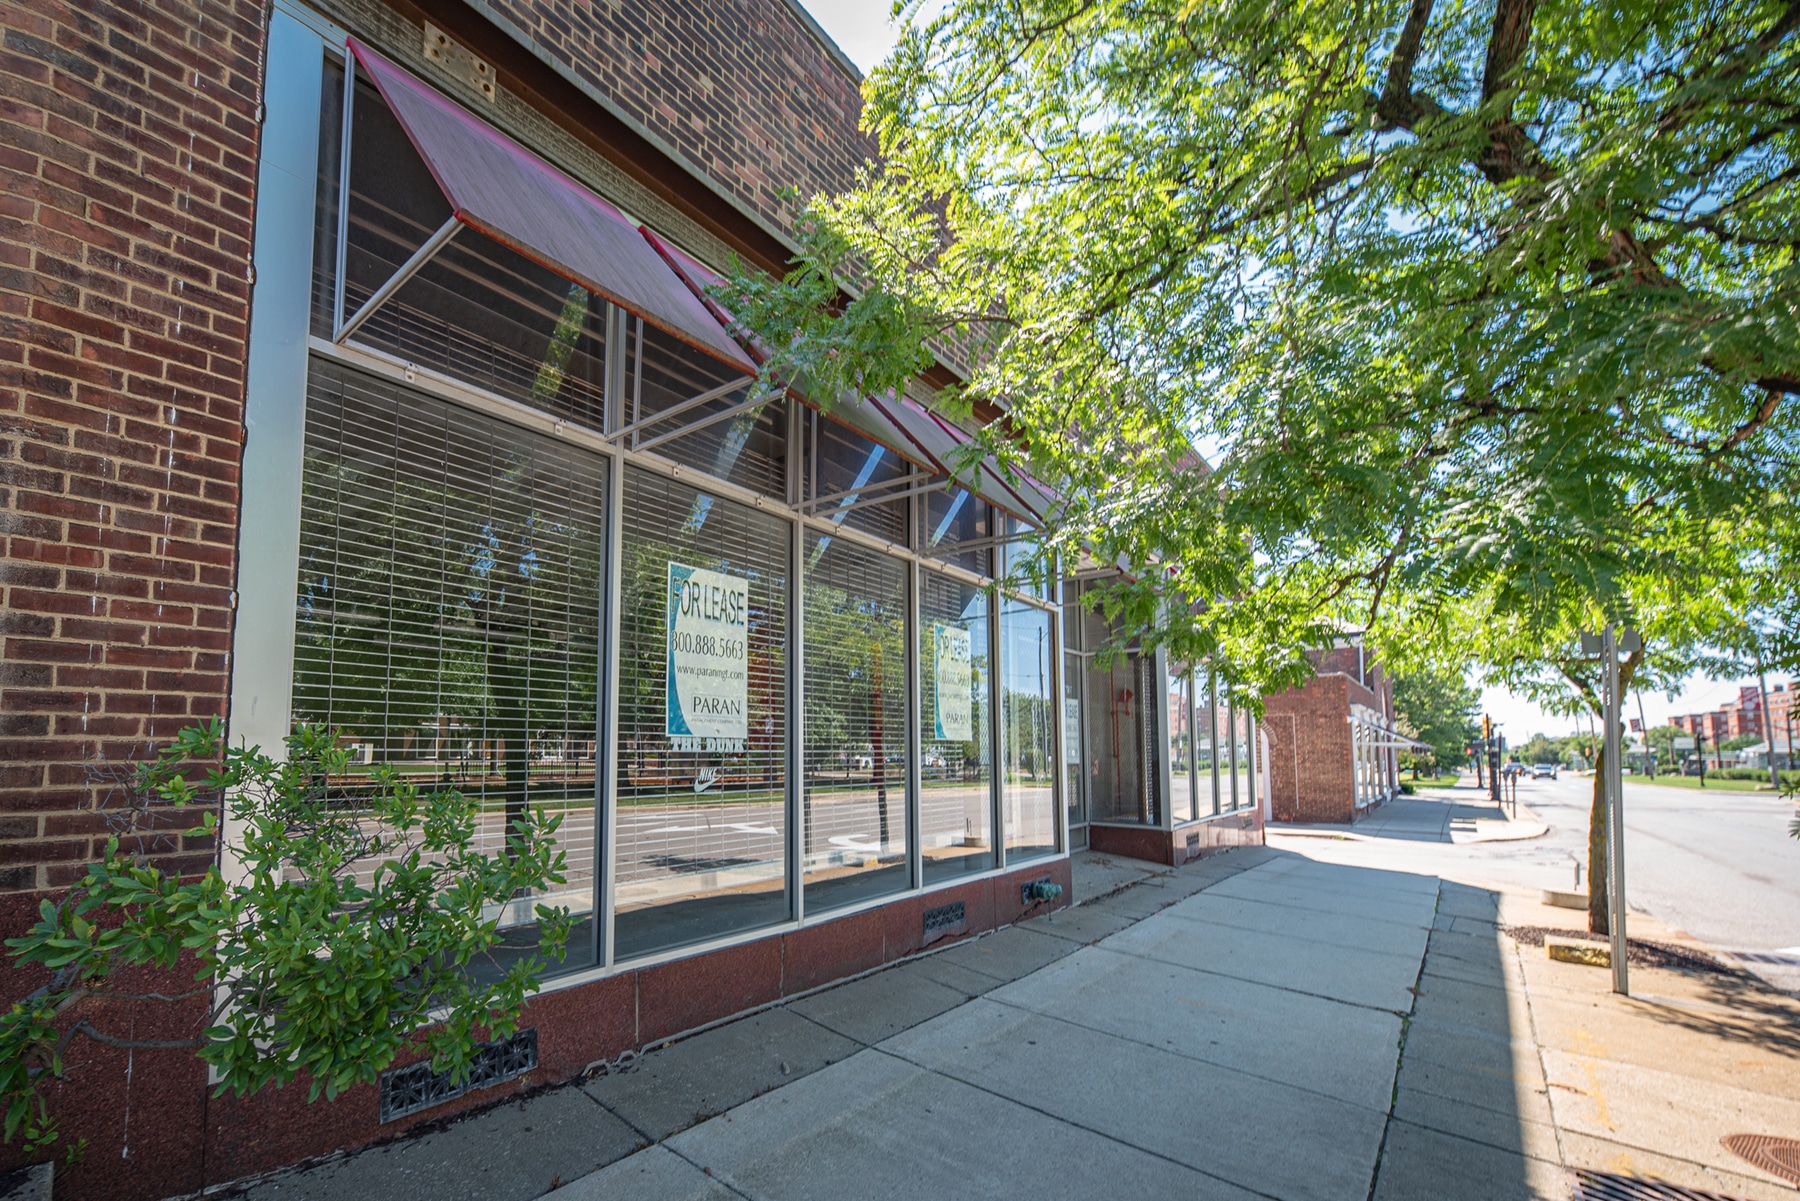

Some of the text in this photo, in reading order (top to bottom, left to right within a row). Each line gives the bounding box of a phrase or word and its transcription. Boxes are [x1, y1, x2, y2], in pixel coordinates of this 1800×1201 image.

[671, 576, 744, 626] FOR LEASE
[671, 630, 743, 660] 800.888.5663
[677, 665, 744, 681] www.paranmgt.com
[693, 696, 740, 715] PARAN
[946, 712, 968, 724] PARAN
[671, 736, 744, 753] THE DUNK
[699, 767, 718, 781] NIKE
